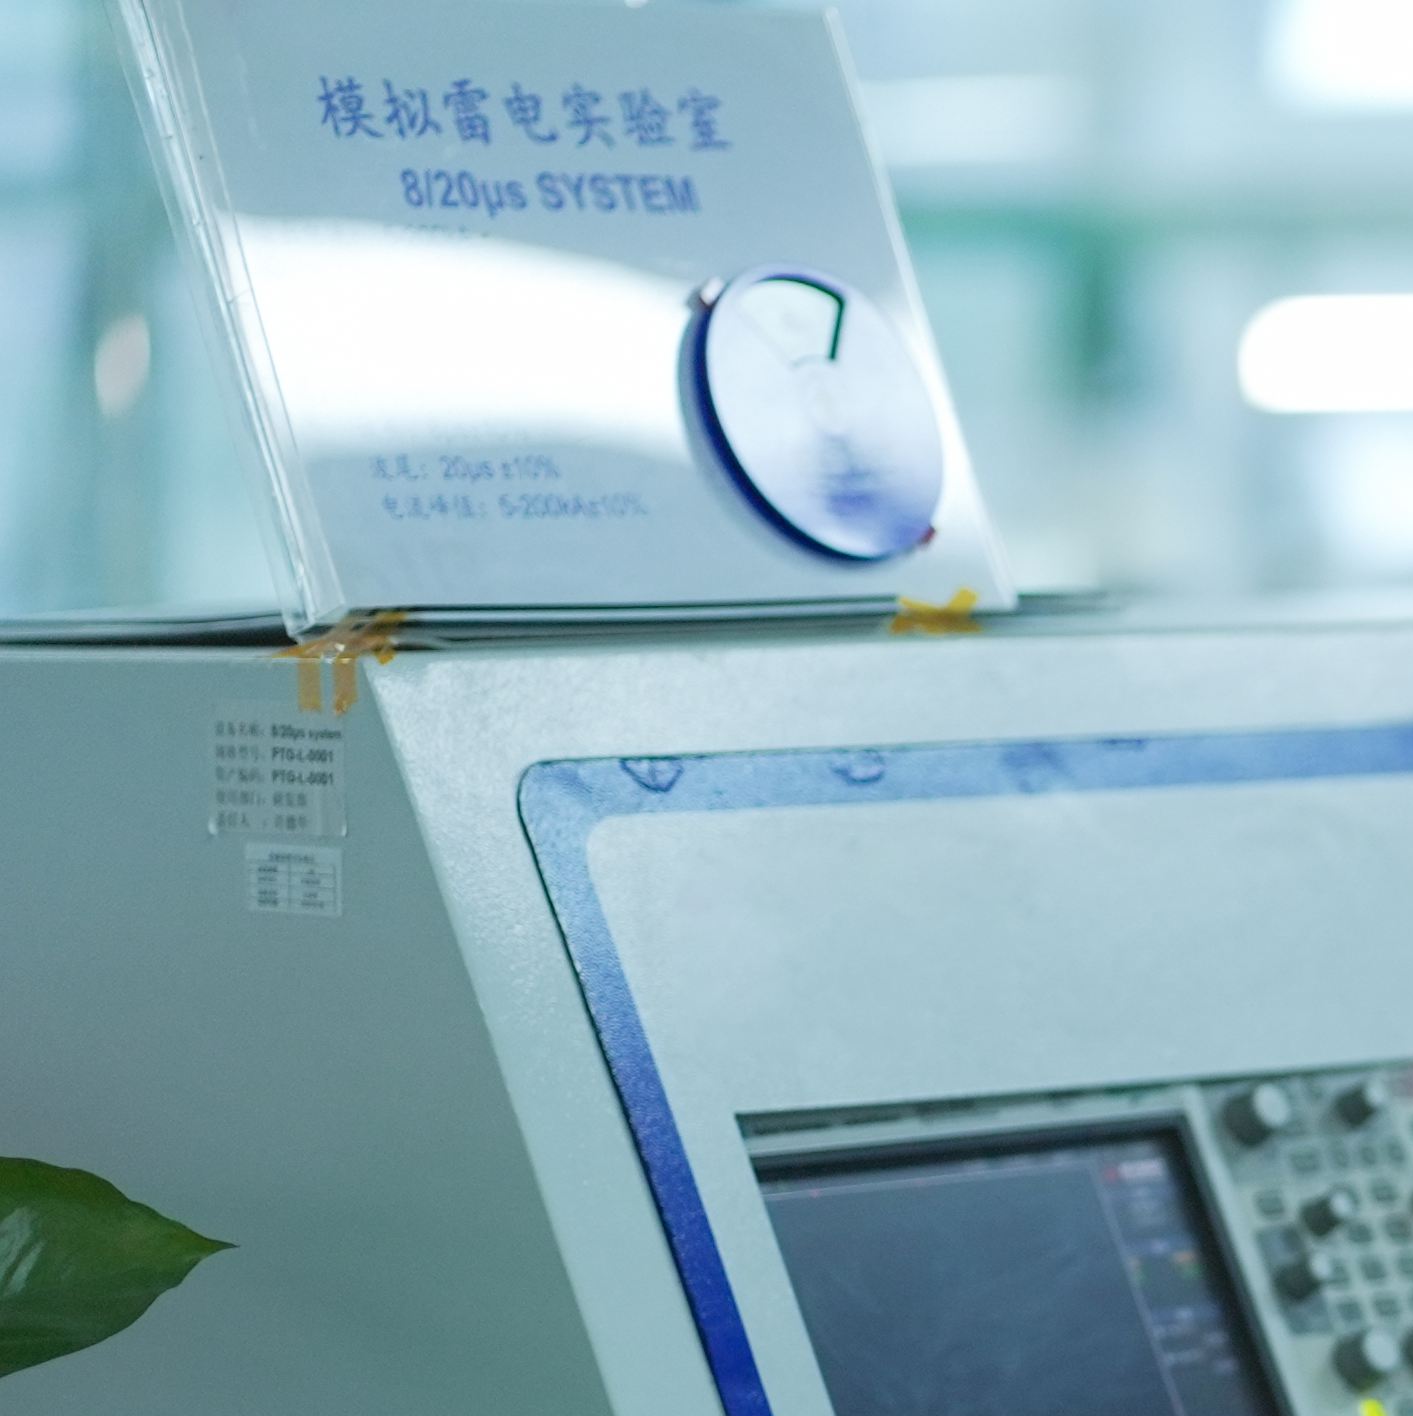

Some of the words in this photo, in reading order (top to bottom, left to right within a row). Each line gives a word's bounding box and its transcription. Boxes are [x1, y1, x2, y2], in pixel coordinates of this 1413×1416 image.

[317, 76, 732, 151] 模拟雷电实验室
[400, 167, 529, 219] 8/20μs
[535, 171, 701, 214] SYSTEM
